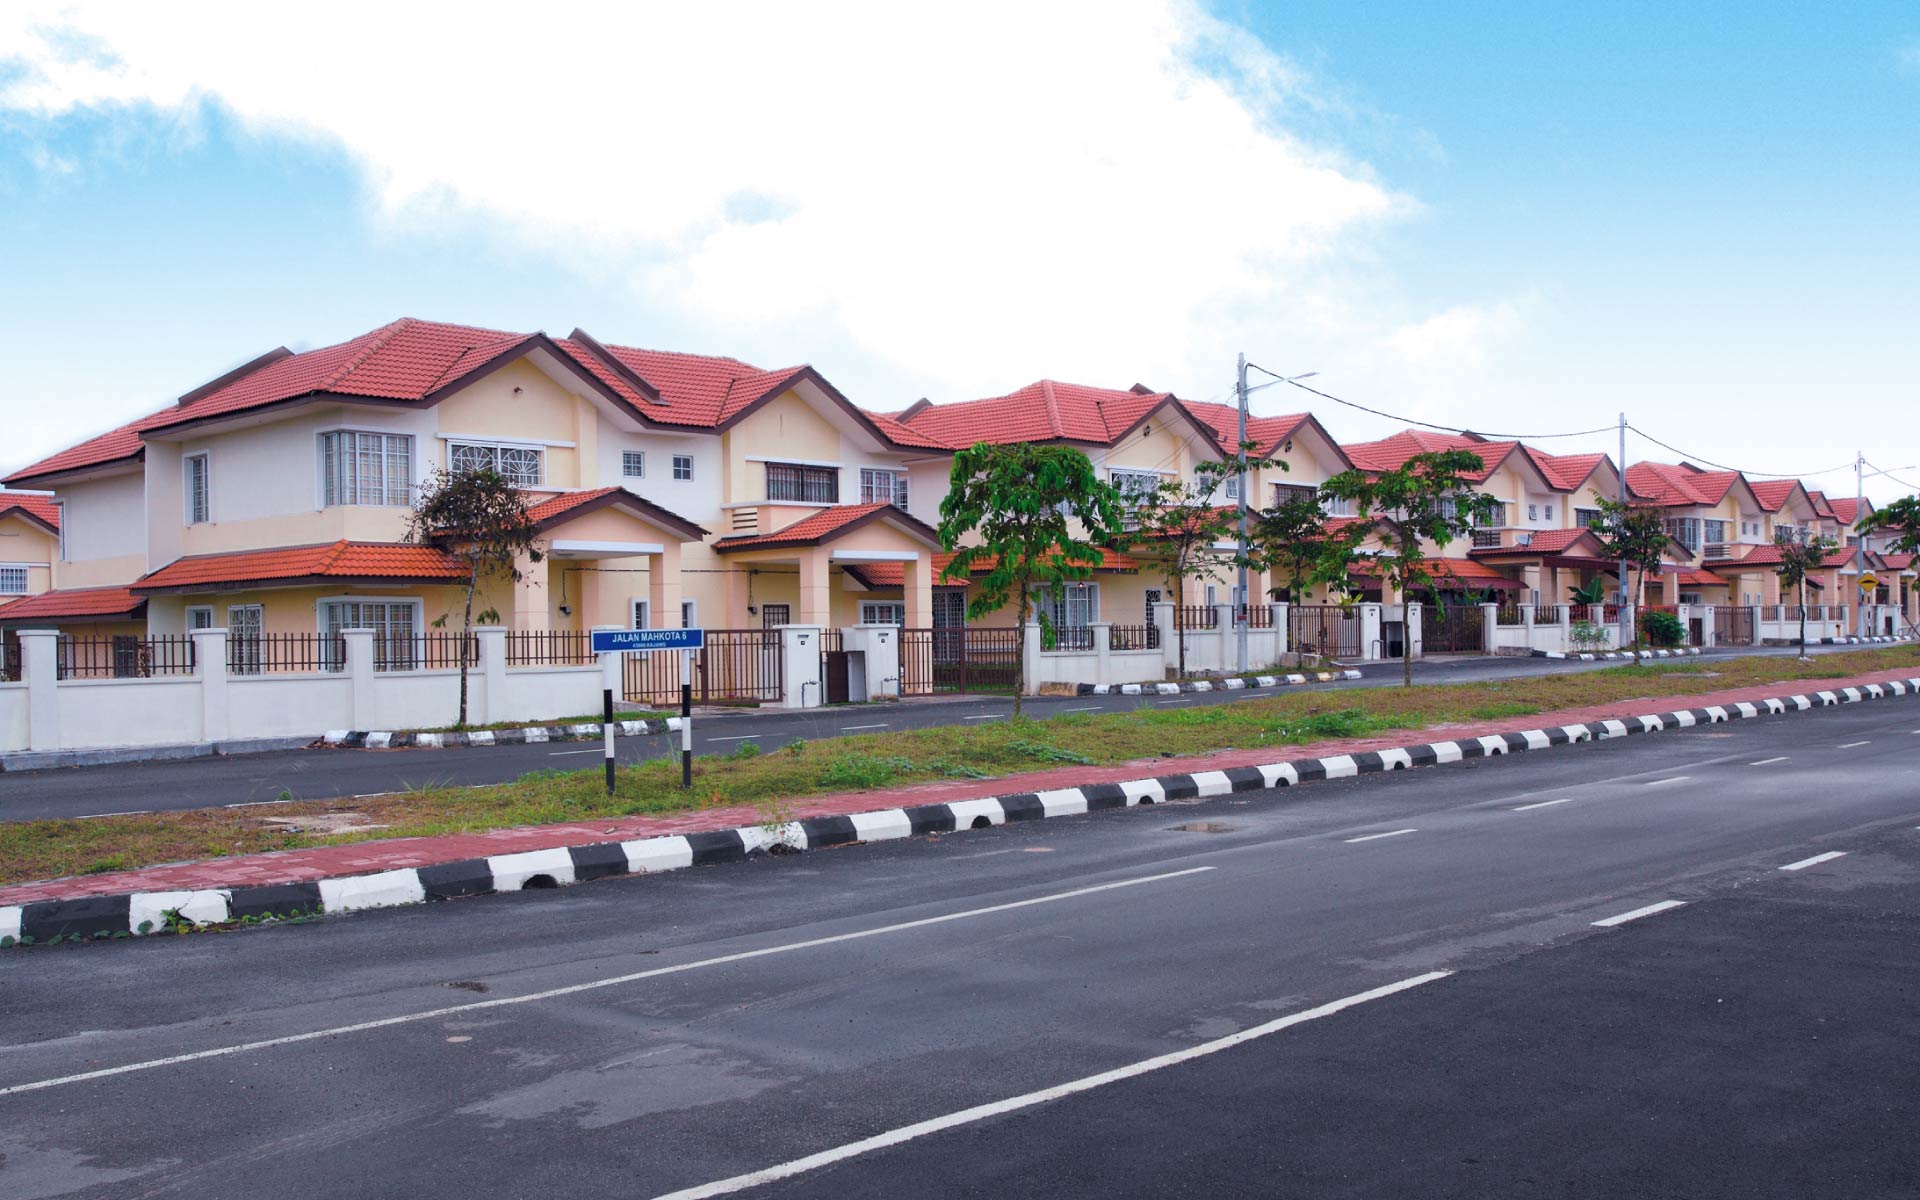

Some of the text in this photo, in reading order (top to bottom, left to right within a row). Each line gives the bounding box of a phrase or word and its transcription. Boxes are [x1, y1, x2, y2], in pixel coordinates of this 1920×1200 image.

[612, 631, 687, 643] JALAN MAHKOTA 6
